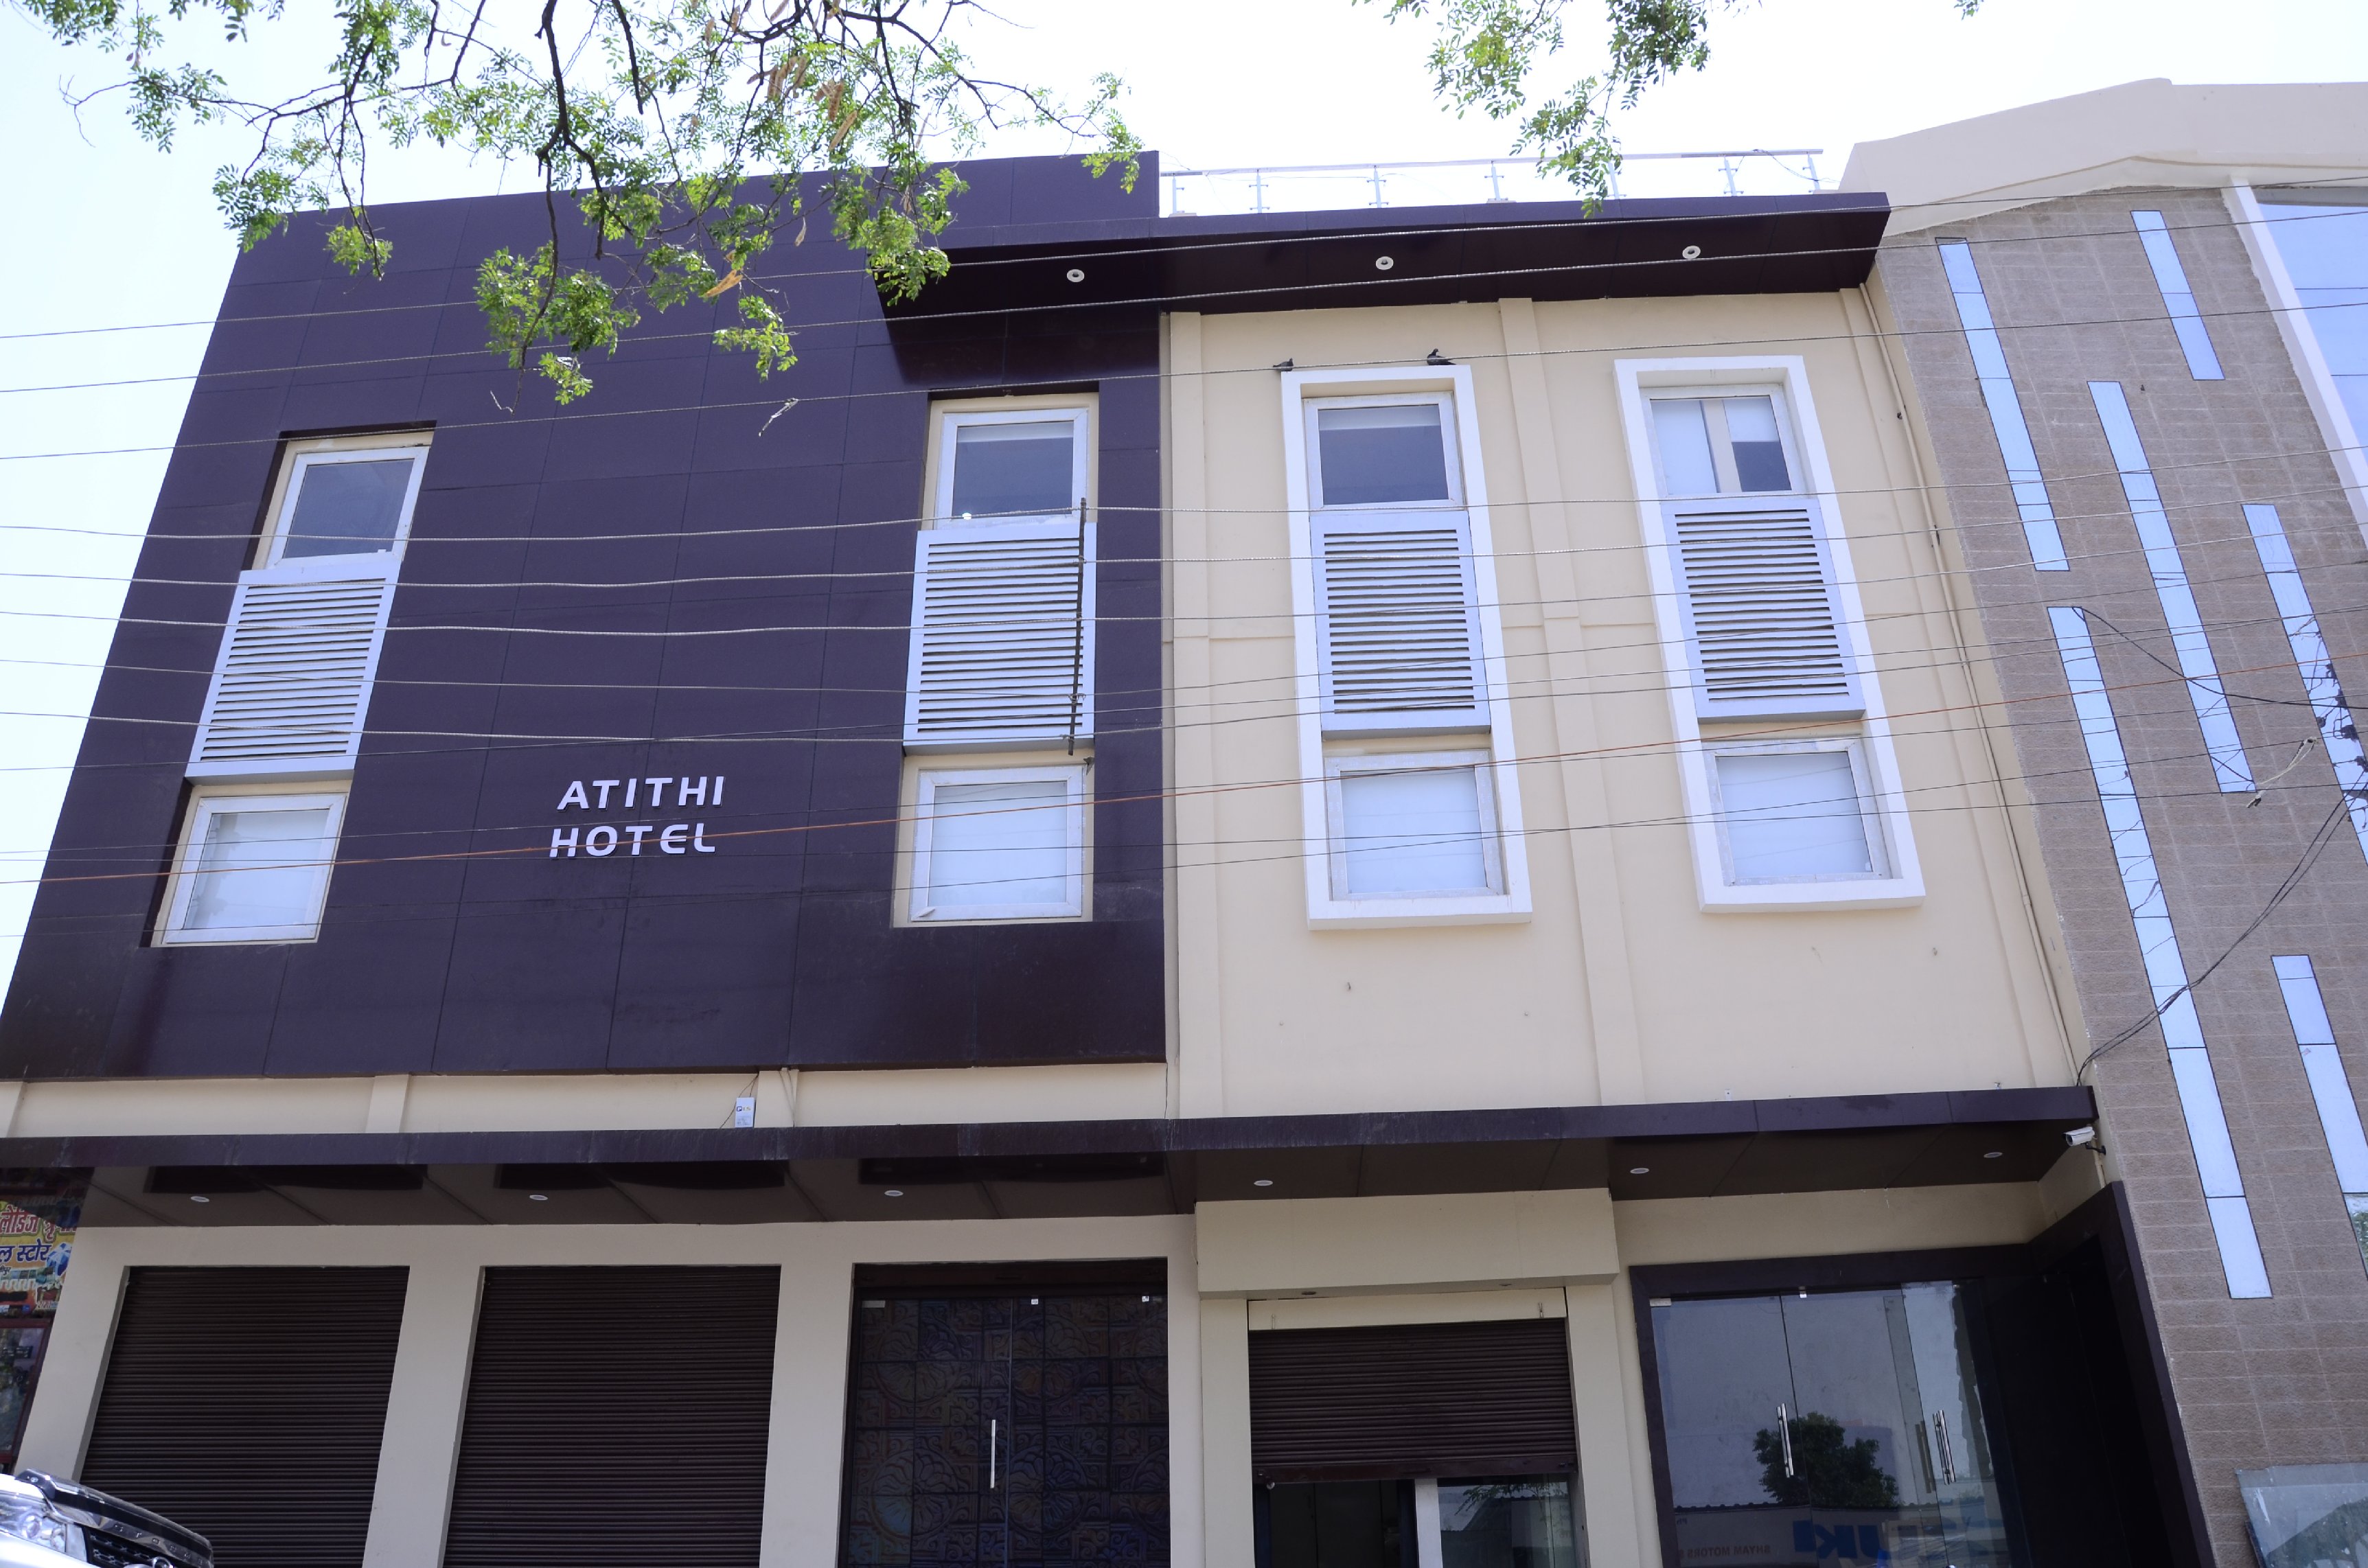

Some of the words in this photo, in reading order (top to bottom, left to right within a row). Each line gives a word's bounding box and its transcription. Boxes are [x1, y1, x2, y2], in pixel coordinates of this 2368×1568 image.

[556, 776, 725, 811] ATITHI
[549, 823, 716, 858] HOTEL
[17, 1238, 52, 1262] स्टोर
